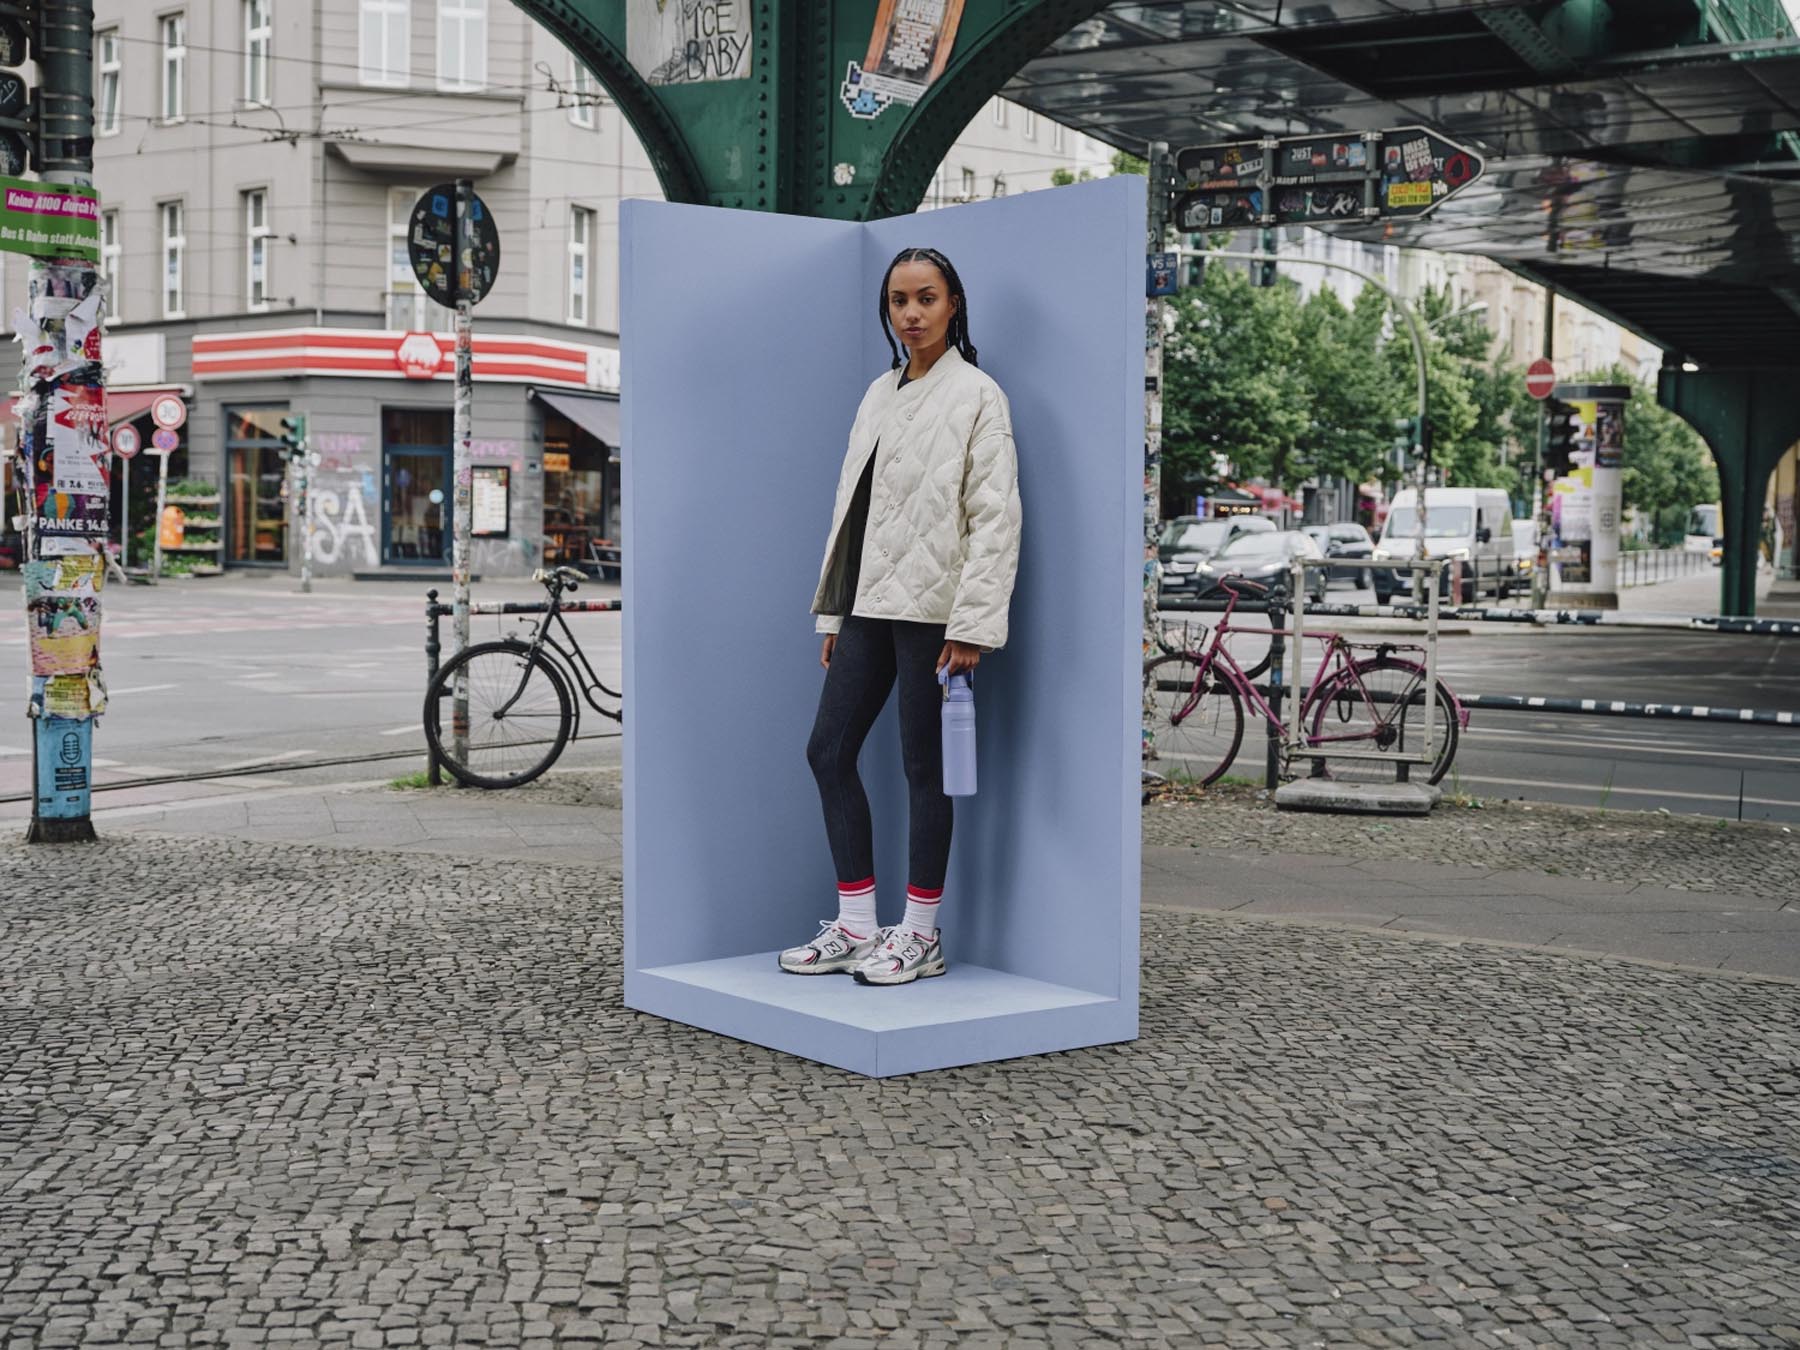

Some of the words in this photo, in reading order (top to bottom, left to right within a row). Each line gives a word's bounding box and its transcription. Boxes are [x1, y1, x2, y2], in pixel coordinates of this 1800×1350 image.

[694, 1, 736, 39] ICE
[687, 33, 749, 80] BABY
[8, 191, 34, 208] Keine
[34, 195, 61, 211] A100
[62, 198, 90, 214] durch
[0, 225, 17, 239] Bus
[18, 227, 25, 241] &
[26, 229, 49, 243] Bahn
[49, 232, 75, 245] statt
[39, 517, 84, 531] PANKE
[823, 941, 844, 956] N
[901, 946, 919, 961] N
